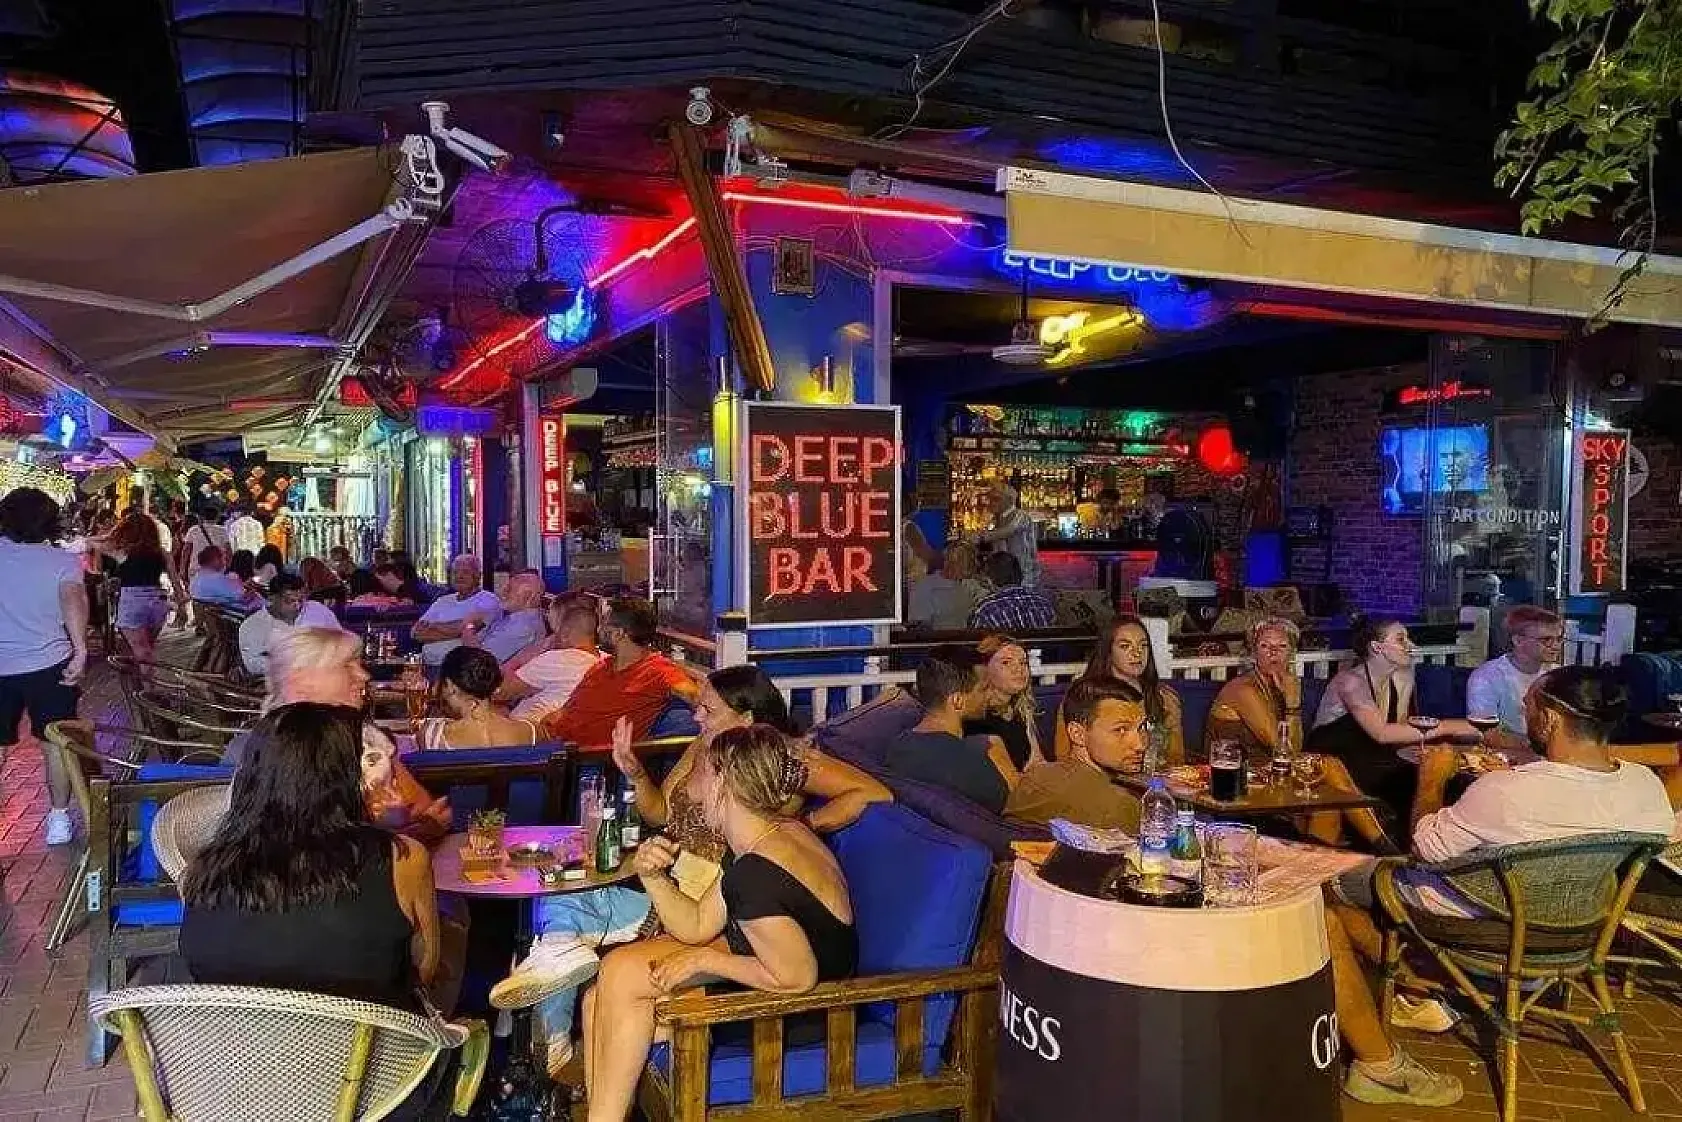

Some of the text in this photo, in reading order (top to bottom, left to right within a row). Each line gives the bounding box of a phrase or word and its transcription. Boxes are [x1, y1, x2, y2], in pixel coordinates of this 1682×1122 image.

[752, 434, 895, 484] DEEP
[1583, 438, 1626, 461] SKY
[543, 421, 559, 531] DEEP BLUE
[752, 491, 890, 538] BLUE
[1591, 464, 1611, 585] SPORT
[769, 547, 878, 595] BAR
